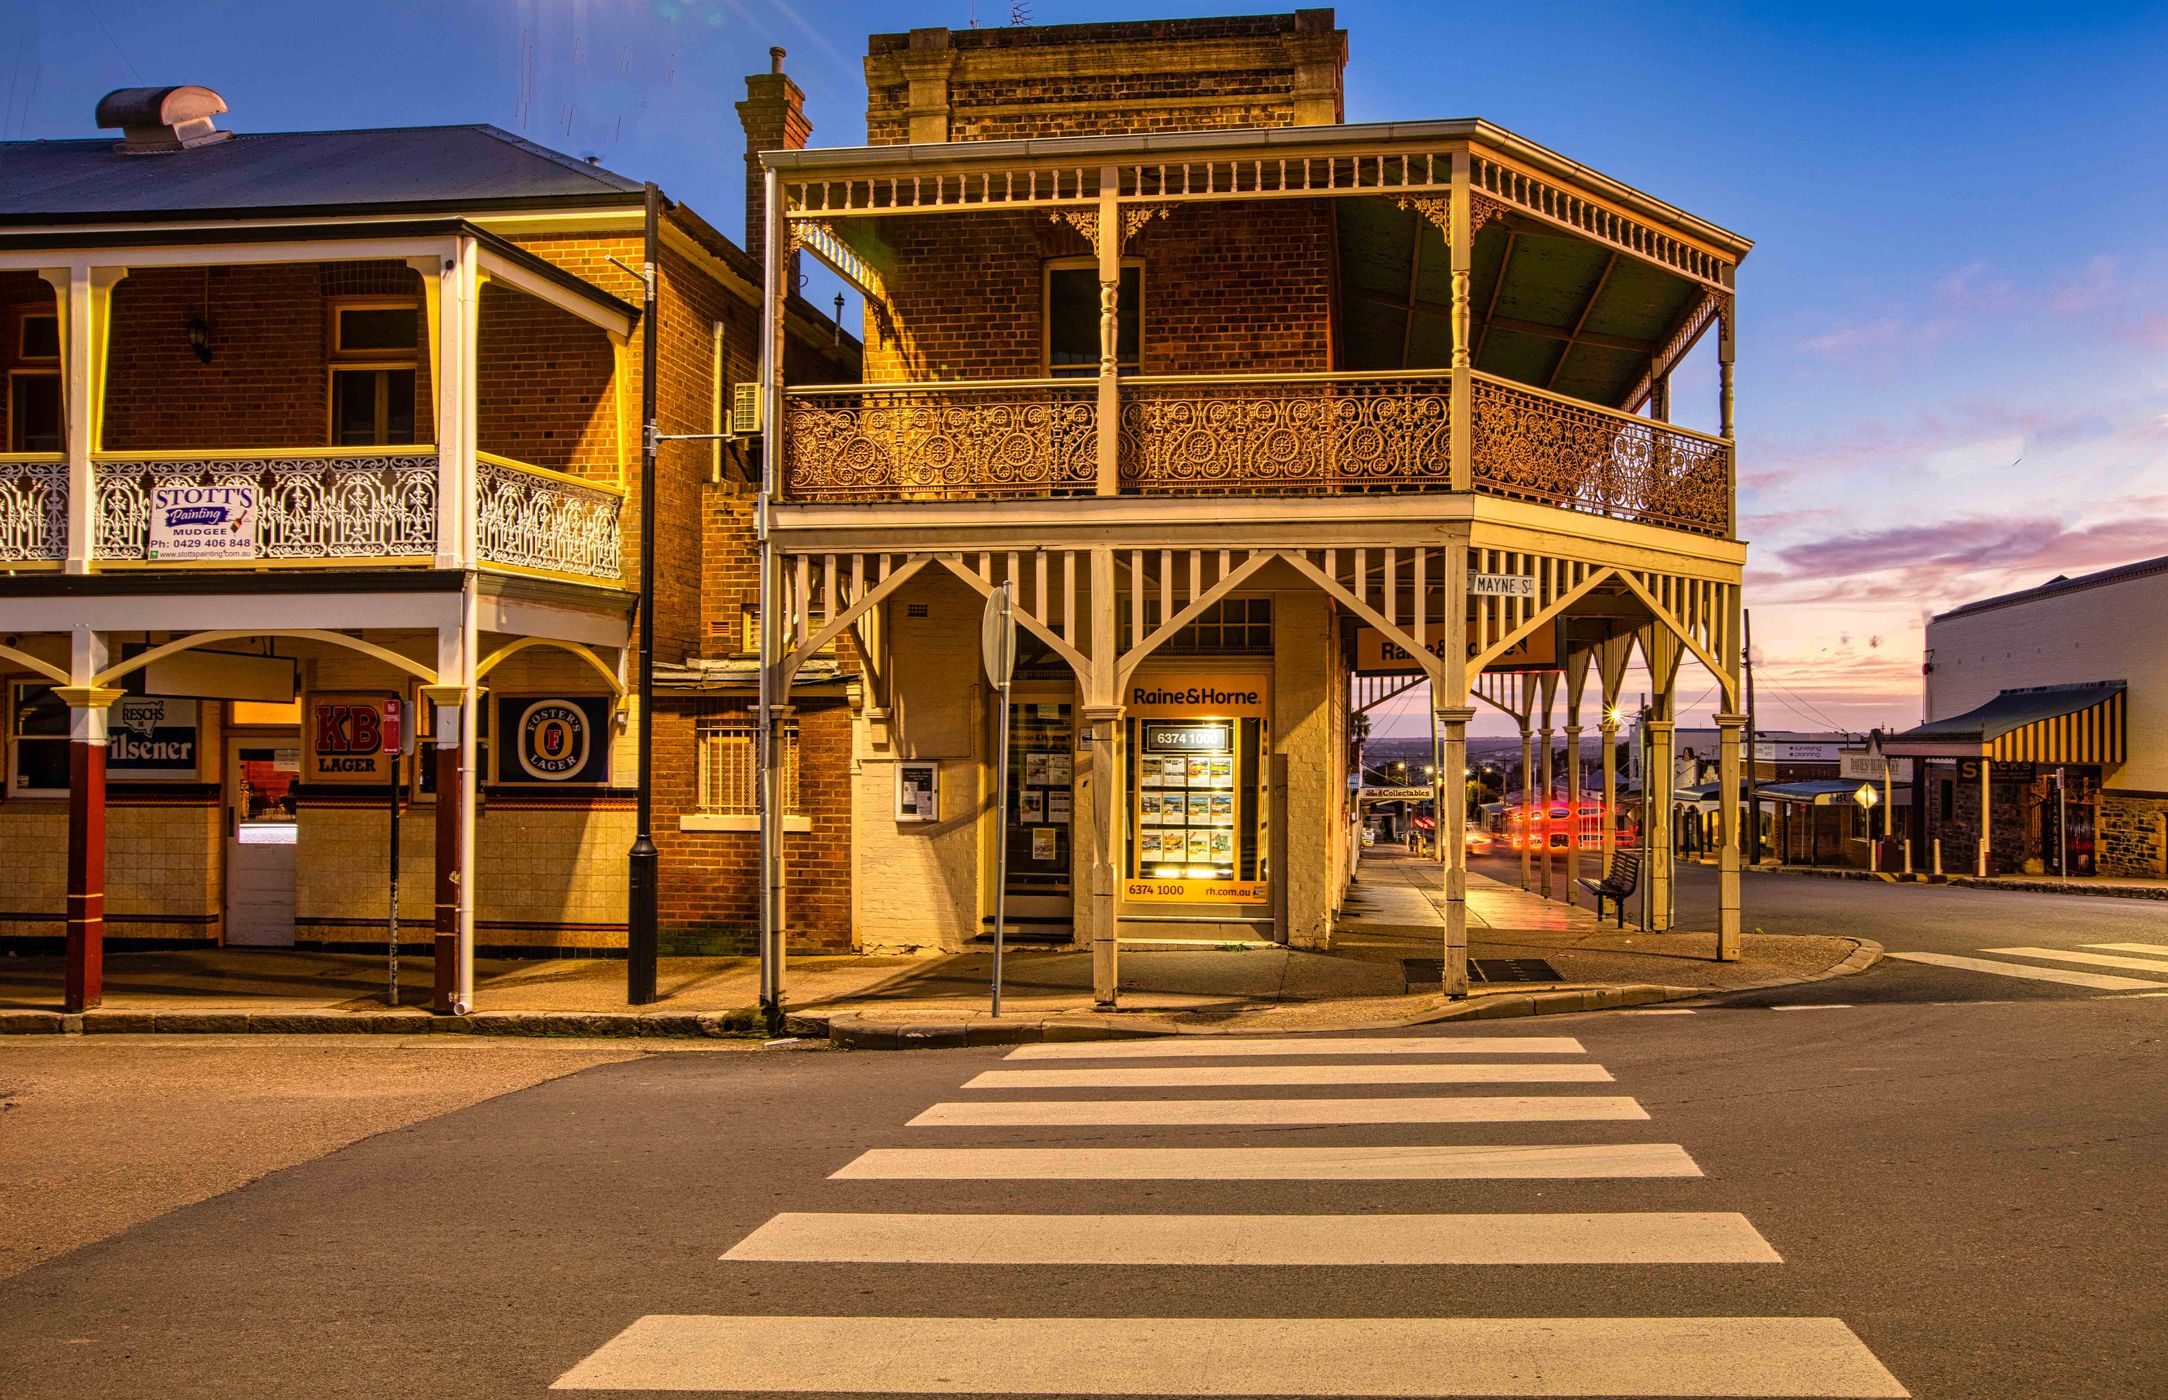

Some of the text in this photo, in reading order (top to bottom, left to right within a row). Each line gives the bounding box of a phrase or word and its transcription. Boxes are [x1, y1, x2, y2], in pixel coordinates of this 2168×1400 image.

[156, 487, 253, 510] STOTT'S
[170, 508, 221, 525] Painting
[173, 528, 228, 536] MUDGEE
[150, 539, 251, 548] Ph: 0429 406 848
[160, 550, 251, 559] www.stottspainting.com.au
[1477, 577, 1533, 594] MAYNE ST
[527, 709, 581, 733] FOSTER'S
[315, 704, 382, 756] KB
[1157, 733, 1187, 744] 6374
[318, 758, 377, 773] LAGER
[529, 753, 577, 771] LAGER
[1962, 761, 2032, 779] SACKS
[1383, 789, 1430, 797] Collectables
[1129, 884, 1251, 897] 6374 1000 rh.com.au
